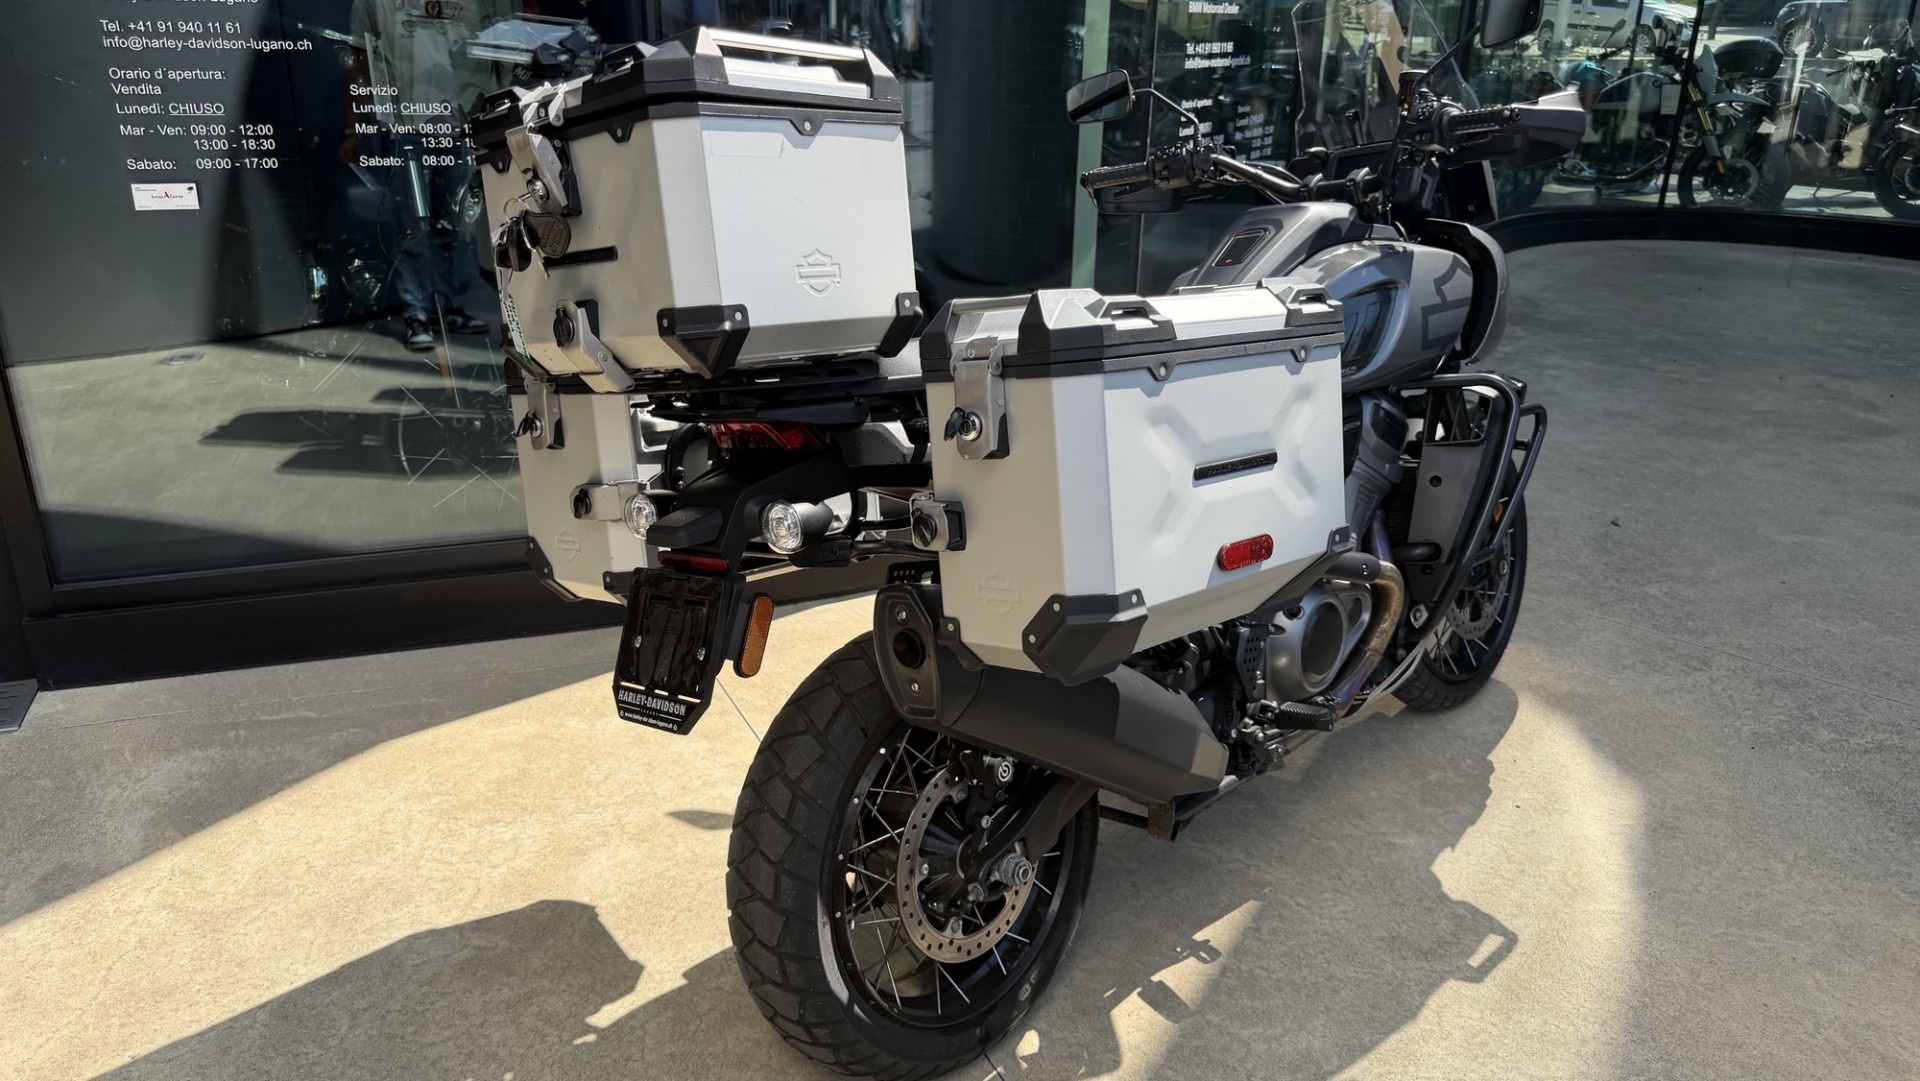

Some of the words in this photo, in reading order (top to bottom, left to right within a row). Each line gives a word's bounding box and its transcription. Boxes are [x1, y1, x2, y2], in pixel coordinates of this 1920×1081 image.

[99, 20, 124, 32] Tel.
[128, 21, 153, 32] +41
[157, 21, 173, 33] 91
[178, 21, 203, 33] 940
[207, 22, 221, 33] 11
[225, 22, 241, 33] 61
[103, 36, 312, 52] info@harley-davidson-lugano.ch
[109, 67, 151, 79] Orario
[111, 83, 162, 95] Vendita
[349, 84, 398, 96] Servizio
[116, 103, 165, 114] Lunedì:
[168, 103, 225, 115] CHIUSO
[352, 102, 397, 113] Lunedì:
[400, 102, 452, 115] CHIUSO
[120, 124, 145, 136] Mar
[157, 124, 187, 136] Ven:
[190, 124, 226, 136] 09:00
[239, 124, 273, 135] 12:00
[355, 123, 378, 134] Mar
[389, 123, 416, 134] Ven:
[419, 123, 452, 134] 08:00
[194, 139, 228, 150] 13:00
[241, 138, 276, 150] 18:30
[421, 137, 453, 148] 13:30
[126, 158, 177, 170] Sabato:
[196, 158, 232, 169] 09:00
[244, 157, 278, 169] 17:00
[359, 155, 405, 167] Sabato:
[422, 155, 455, 166] 08:00
